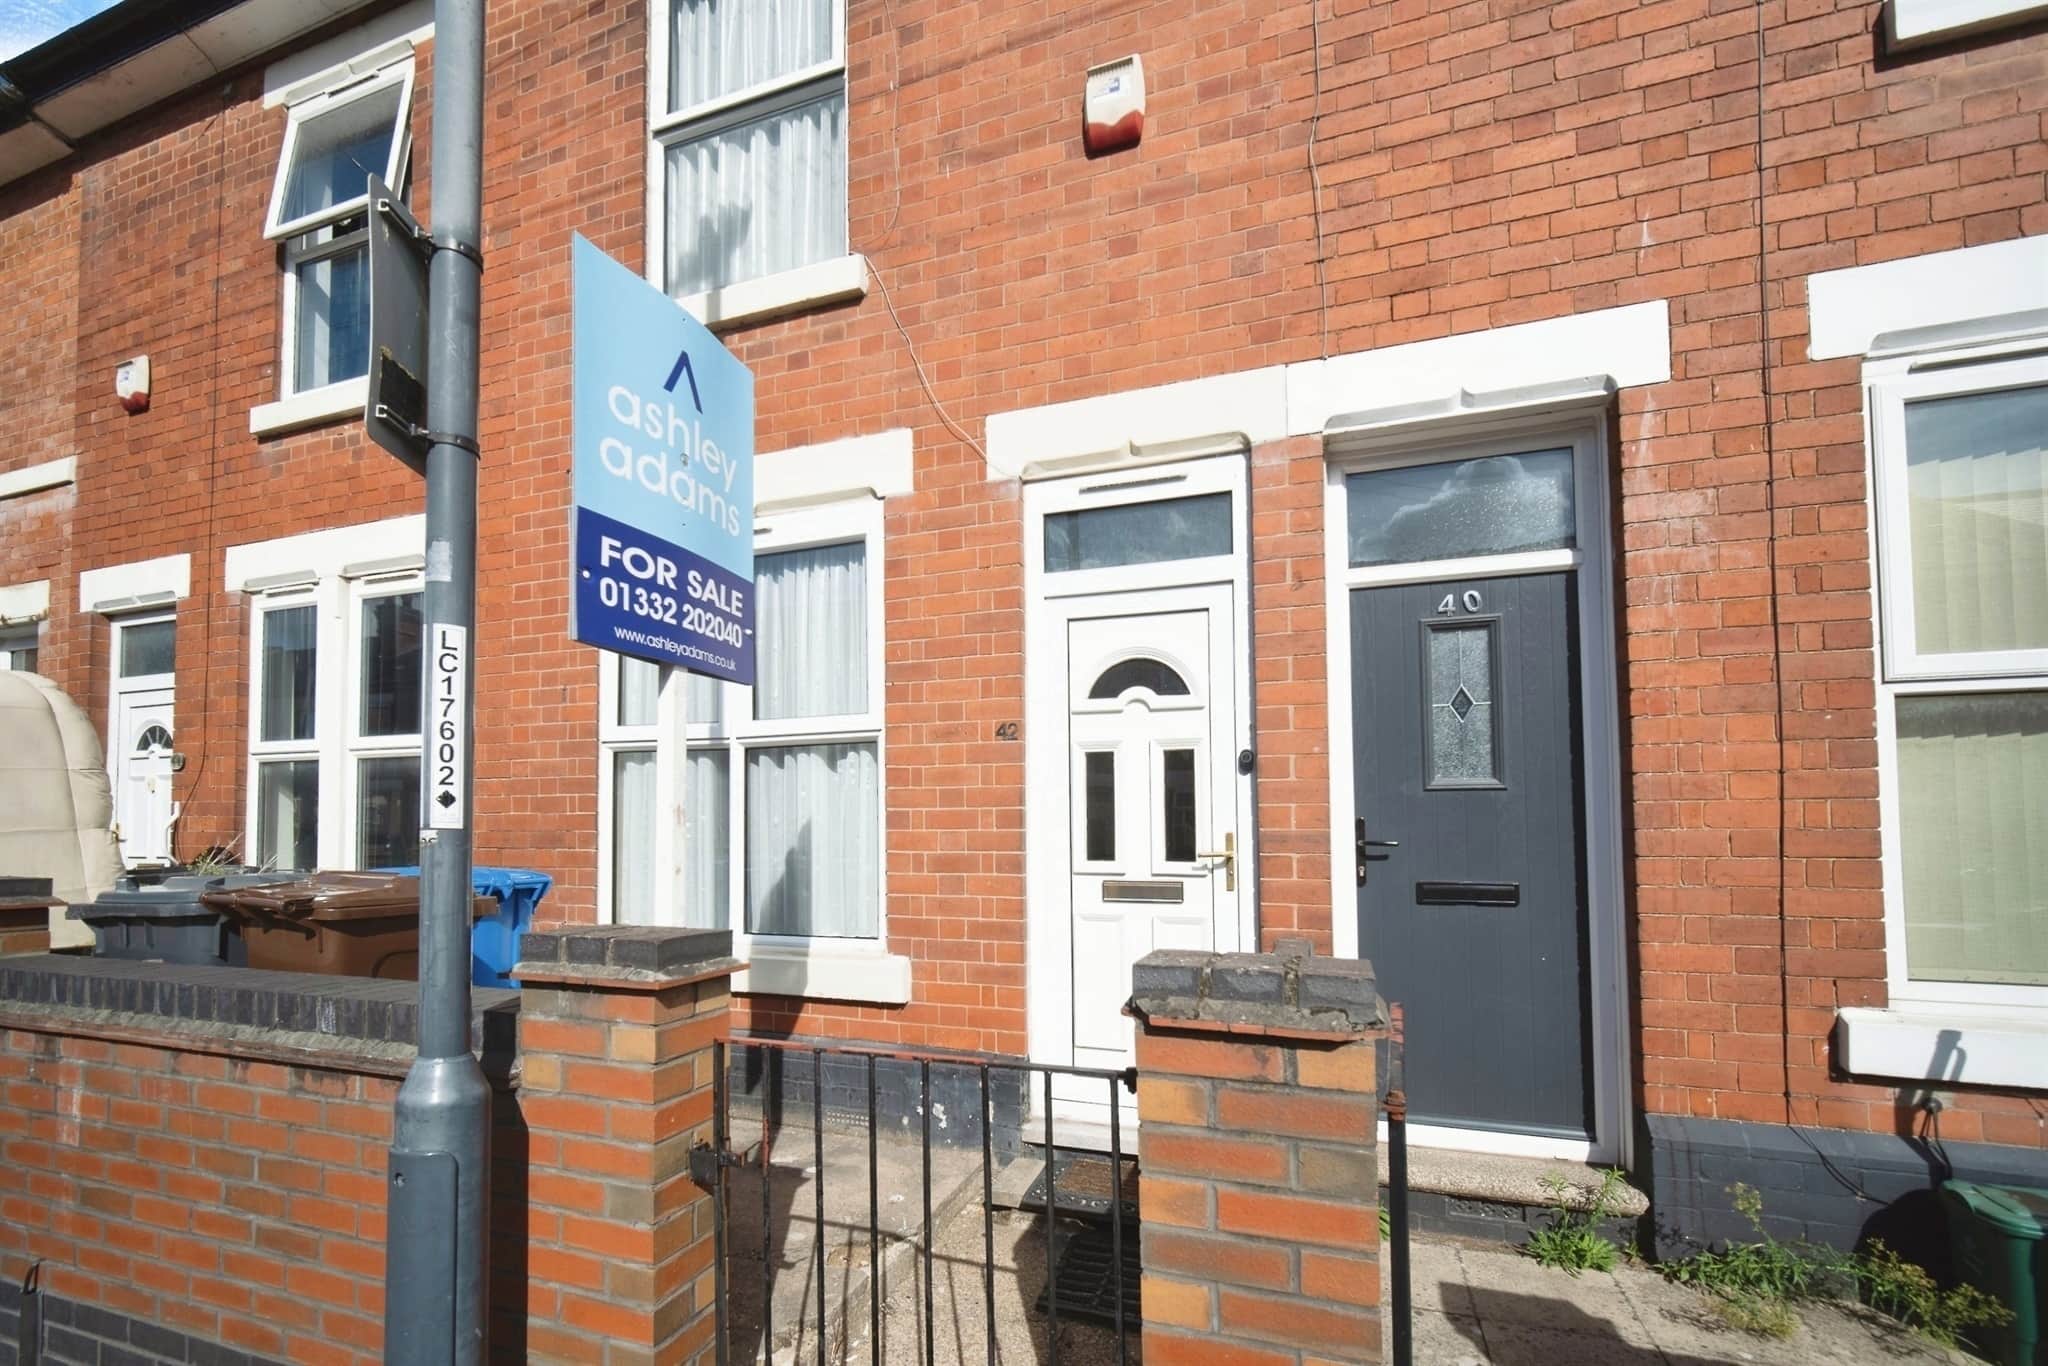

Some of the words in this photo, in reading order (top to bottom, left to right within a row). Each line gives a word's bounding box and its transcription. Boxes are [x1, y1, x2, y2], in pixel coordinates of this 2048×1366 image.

[607, 384, 738, 492] ashley
[600, 436, 740, 537] adams
[600, 535, 678, 590] FOR
[687, 570, 744, 617] SALE
[600, 577, 677, 625] 01332
[682, 604, 742, 648] 202040
[1438, 590, 1482, 616] 40
[614, 626, 737, 672] www.ashleyadams.co.uk
[438, 630, 459, 785] LC17602
[995, 722, 1019, 741] 42
